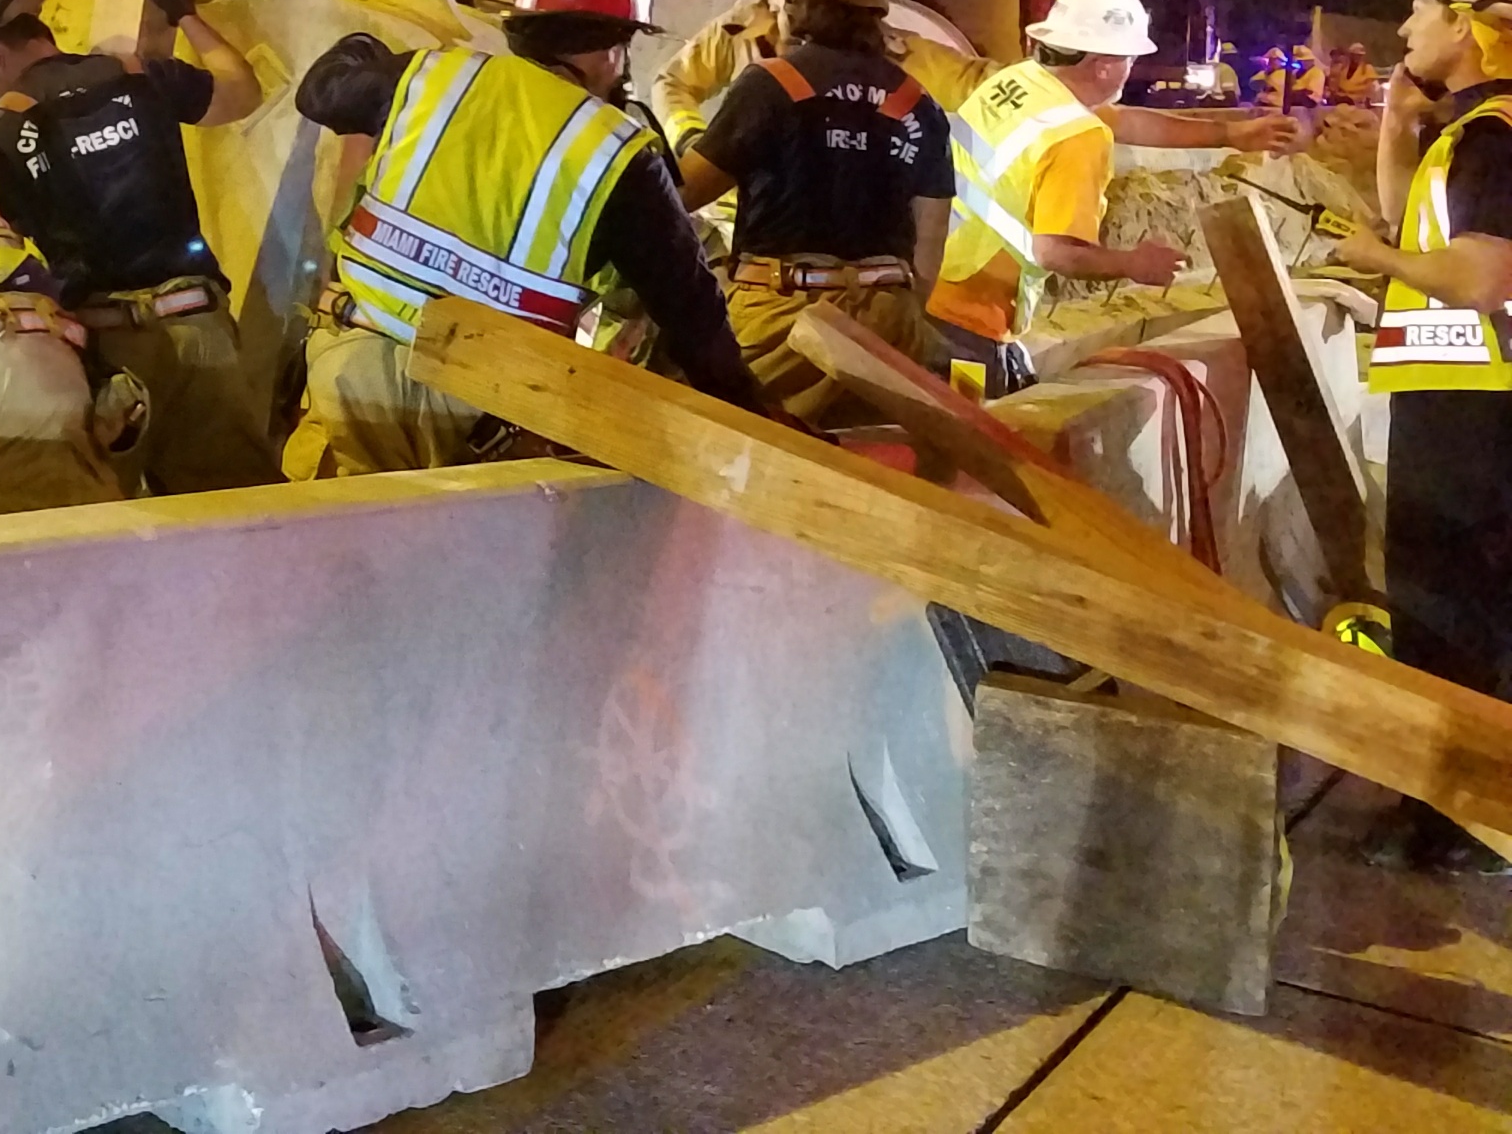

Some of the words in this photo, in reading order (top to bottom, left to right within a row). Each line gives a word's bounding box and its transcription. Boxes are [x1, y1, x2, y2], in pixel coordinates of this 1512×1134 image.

[371, 219, 421, 259] MIAMI
[418, 242, 460, 275] FIRE
[455, 261, 523, 308] RESCUE
[1405, 325, 1484, 347] RESCU
